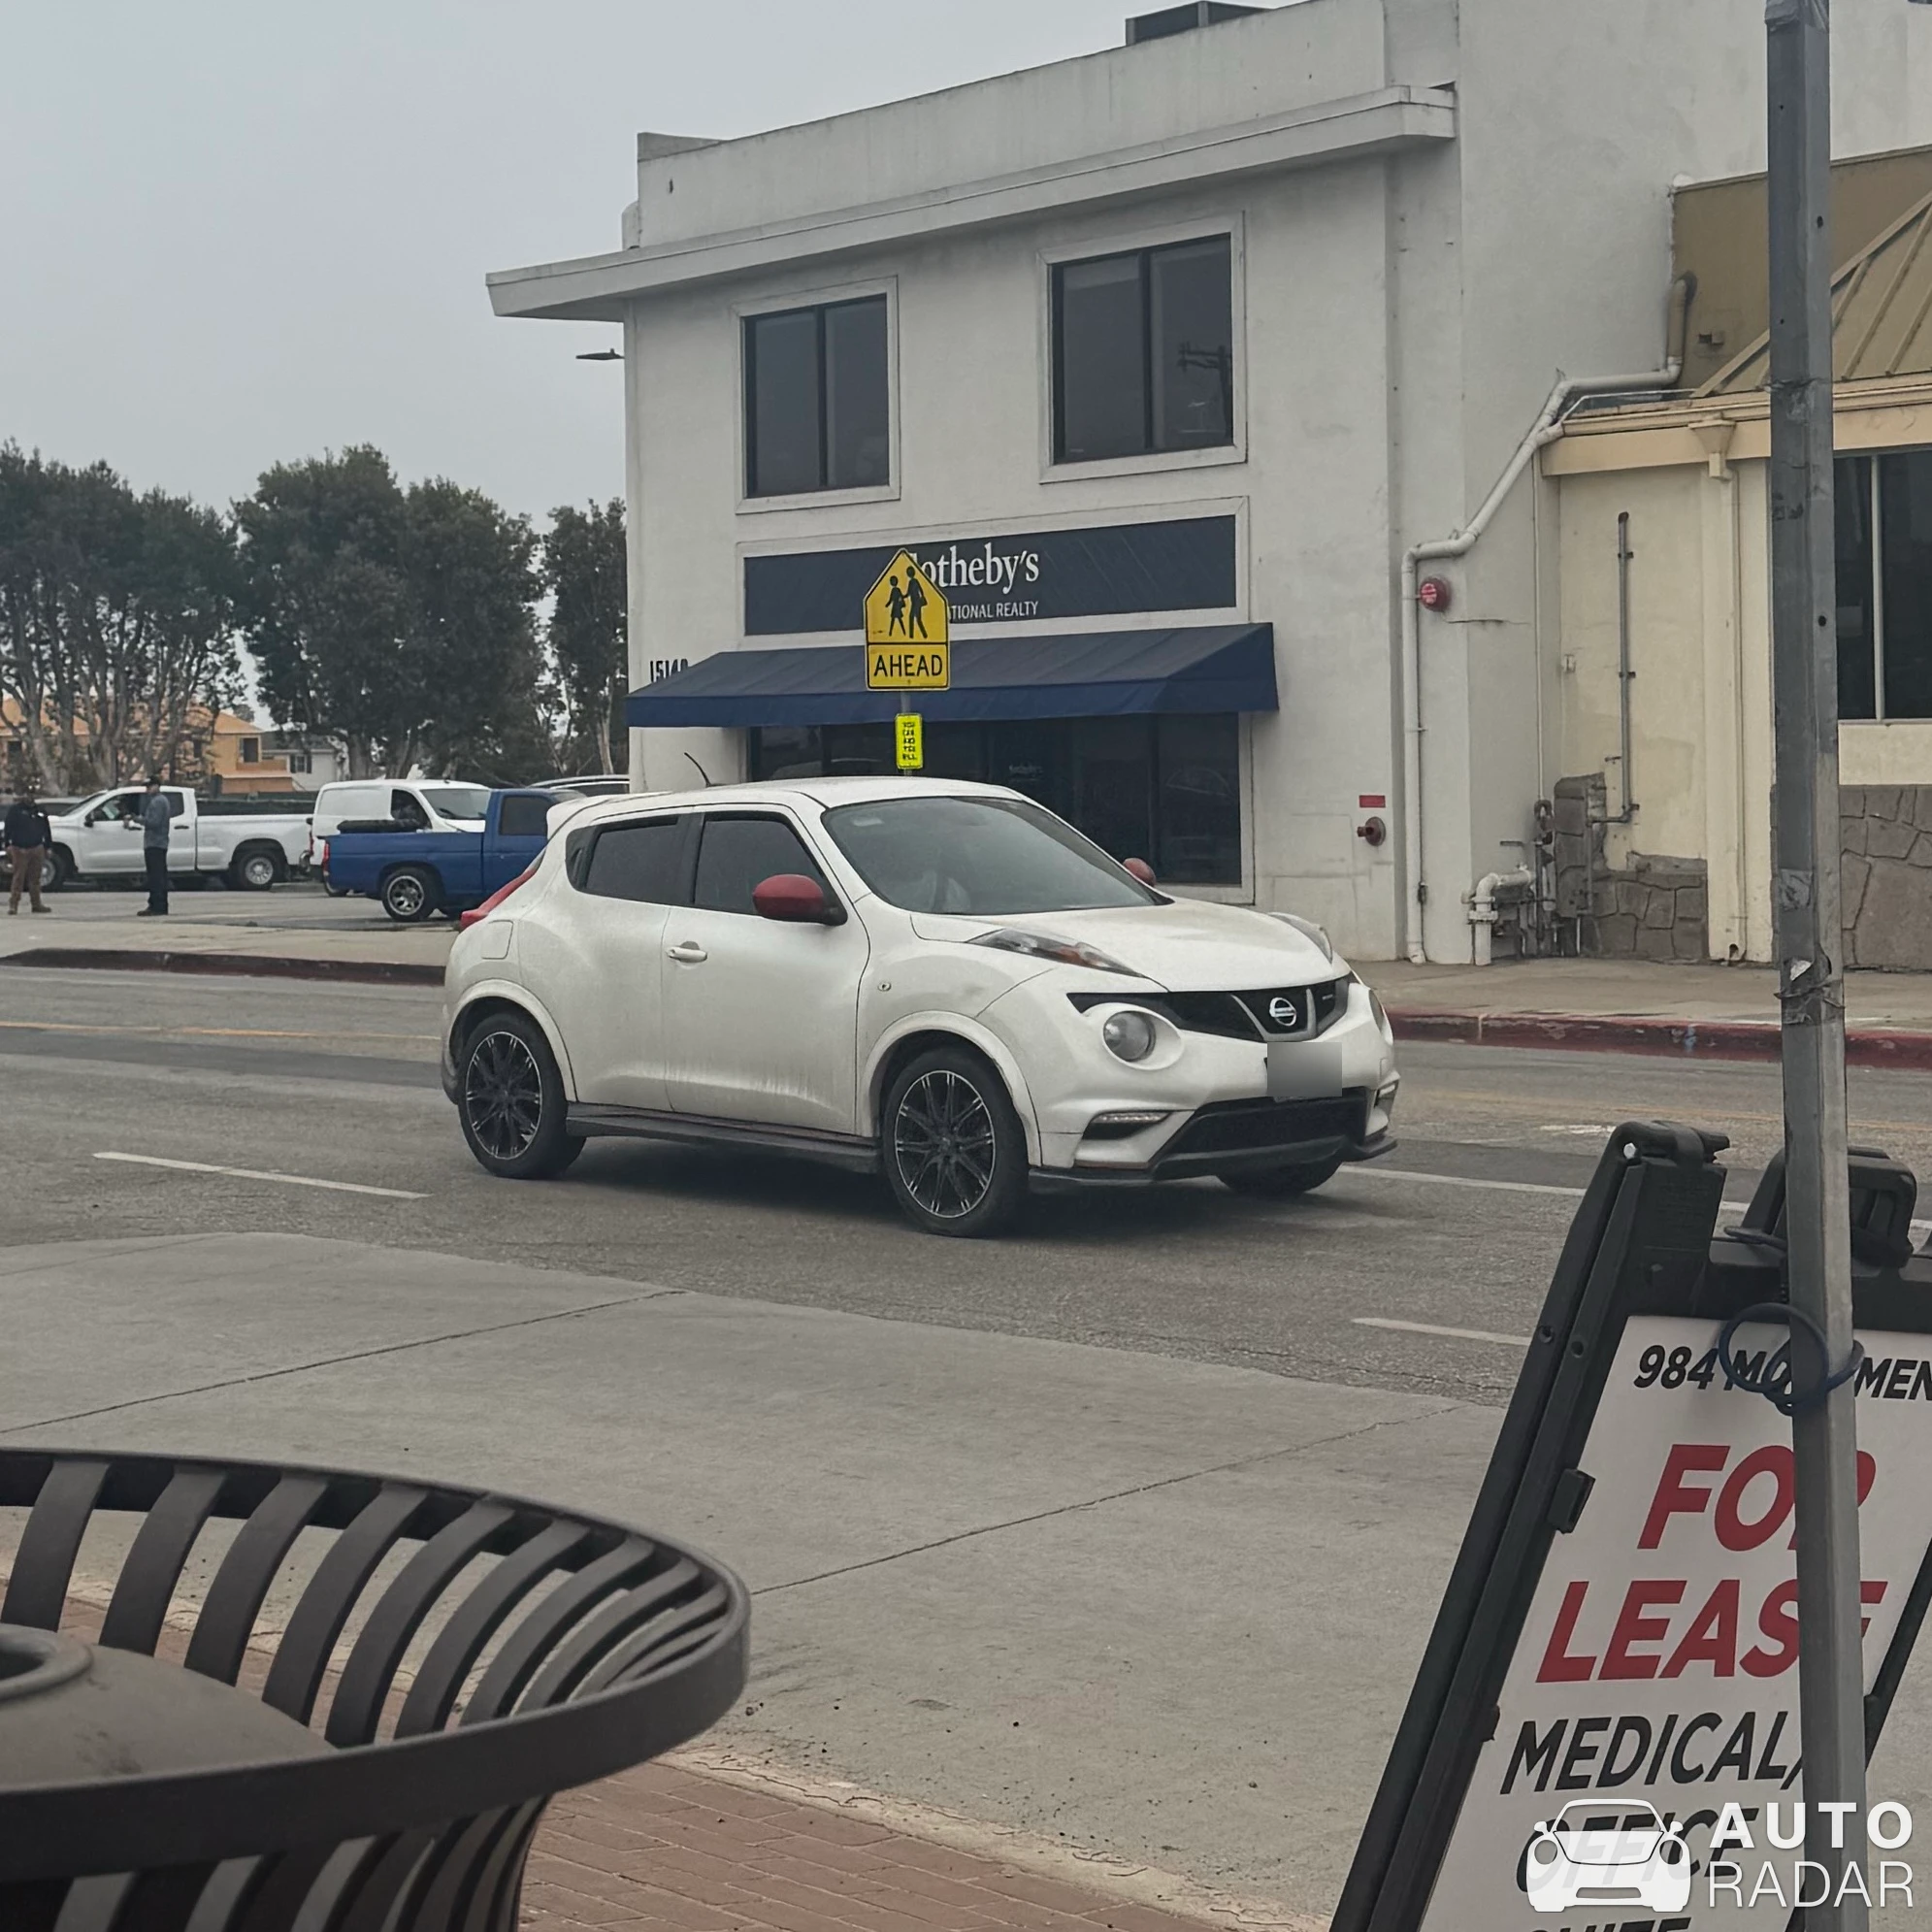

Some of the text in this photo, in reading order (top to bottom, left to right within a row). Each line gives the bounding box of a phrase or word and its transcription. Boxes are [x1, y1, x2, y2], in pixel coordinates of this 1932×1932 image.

[908, 542, 1039, 594] otheby's
[948, 601, 1039, 620] TIONAL REALTY
[873, 654, 943, 677] AHEAD
[1633, 1344, 1719, 1390] 984
